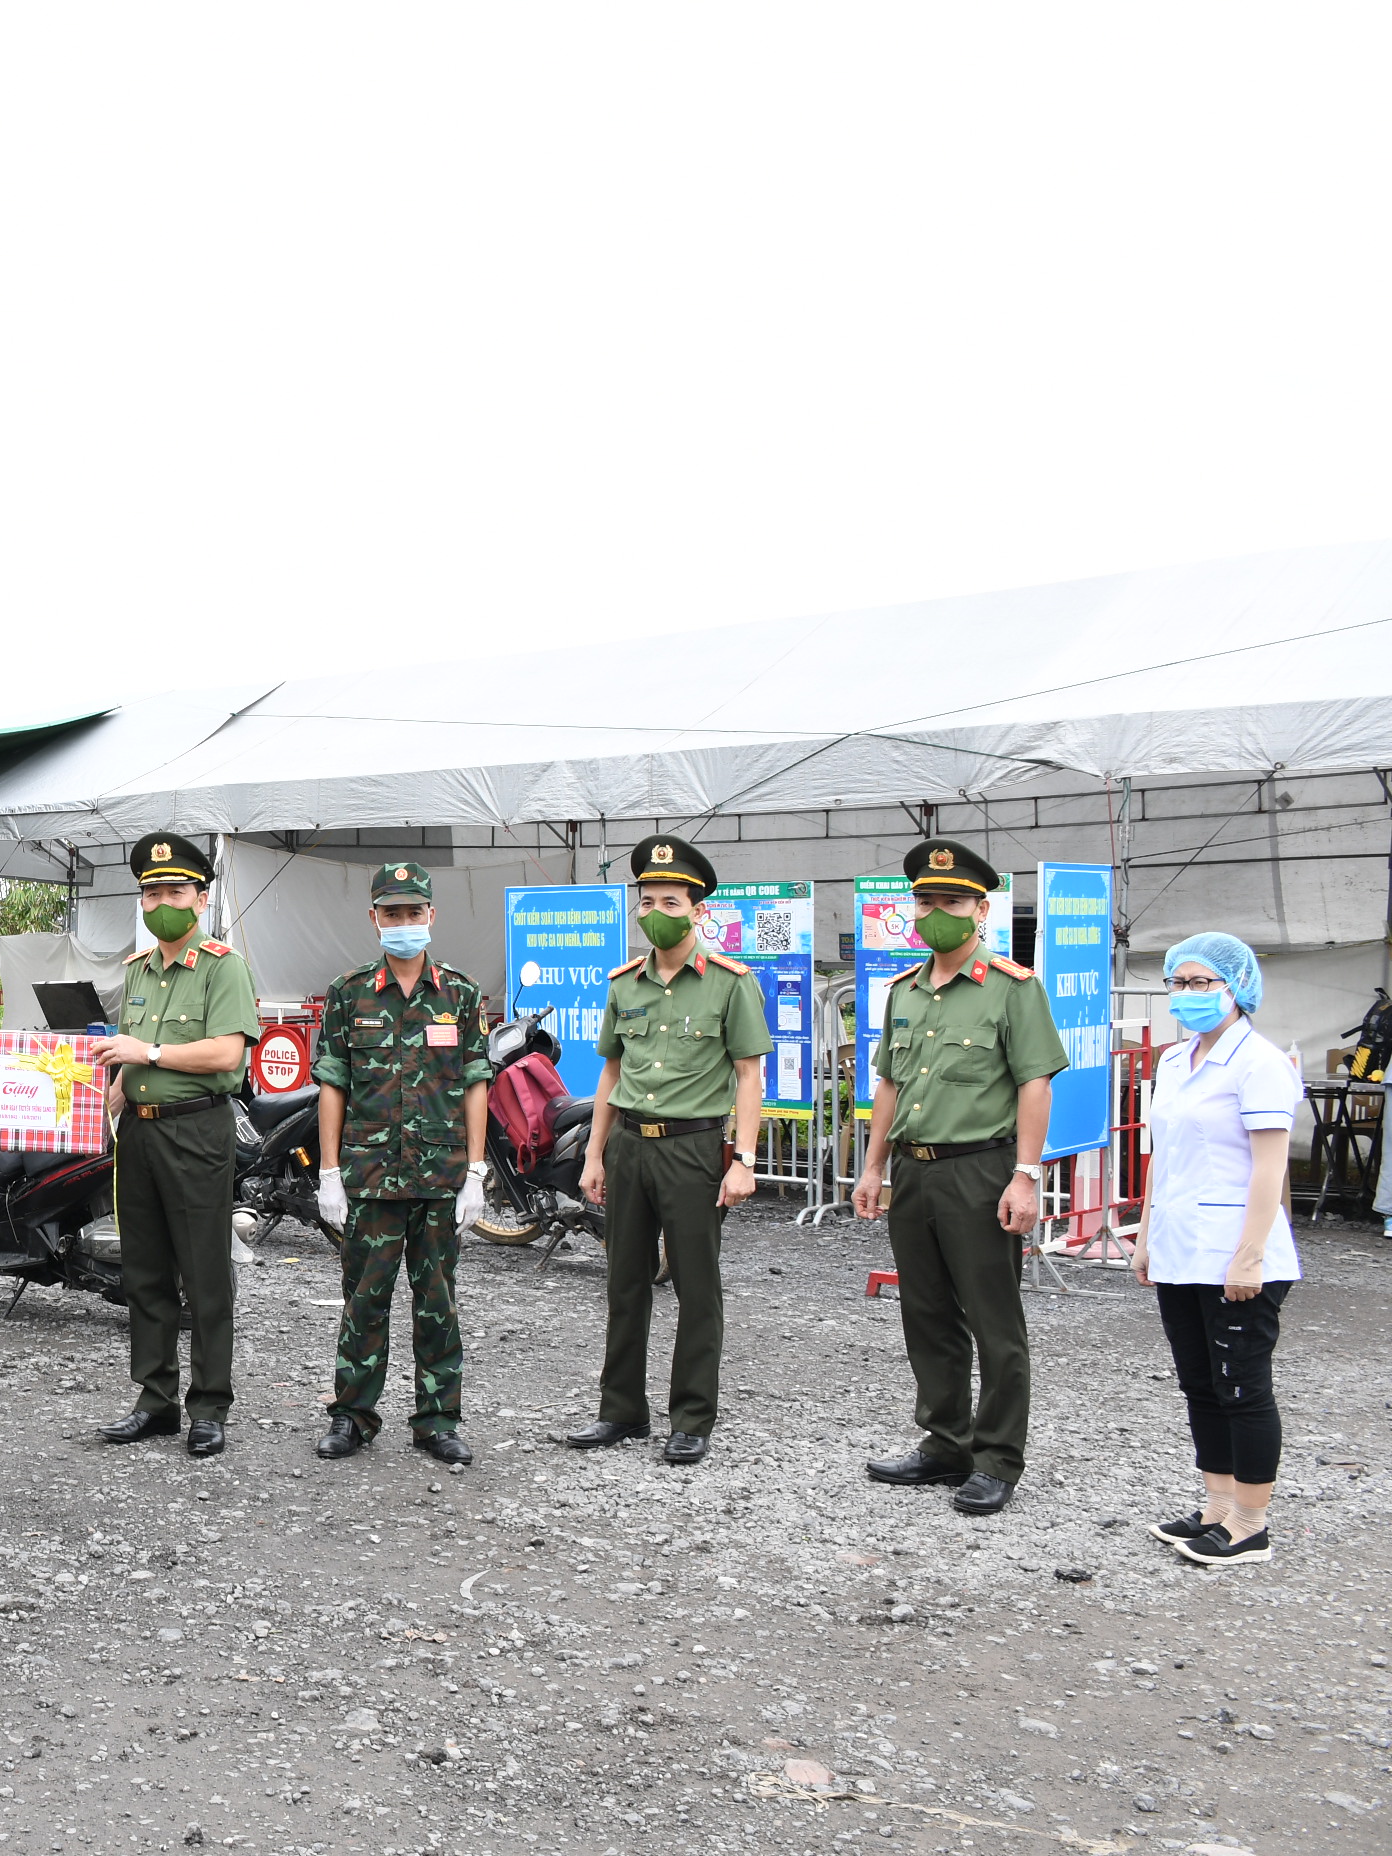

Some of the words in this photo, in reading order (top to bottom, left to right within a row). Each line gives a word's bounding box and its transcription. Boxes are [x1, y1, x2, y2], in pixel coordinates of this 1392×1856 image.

[745, 886, 756, 896] QR
[758, 885, 780, 896] CODE
[582, 910, 606, 924] COVID-19
[615, 910, 618, 924] 1
[568, 965, 602, 989] VỰC
[1056, 972, 1078, 997] KHU
[1079, 969, 1099, 1000] VỰC
[560, 1008, 566, 1040] Y
[568, 996, 580, 1040] TẾ
[265, 1050, 296, 1060] POLICE
[268, 1066, 293, 1077] STOP
[2, 1082, 39, 1099] Tặng
